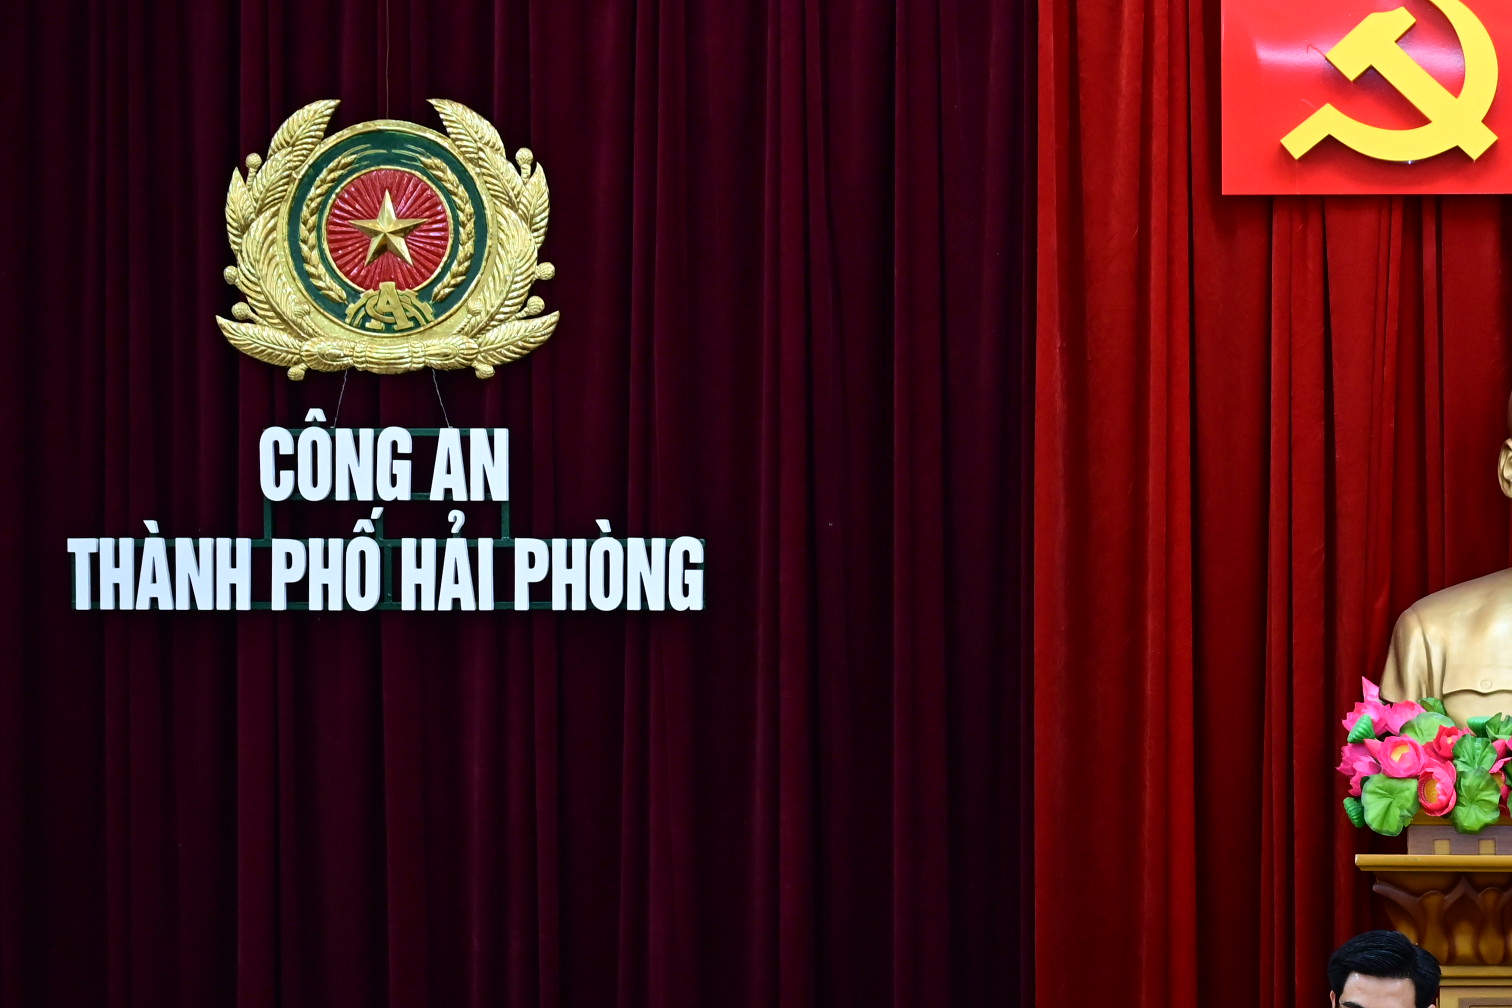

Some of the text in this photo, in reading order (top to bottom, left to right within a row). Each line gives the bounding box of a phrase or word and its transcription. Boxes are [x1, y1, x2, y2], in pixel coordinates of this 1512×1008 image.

[259, 408, 509, 502] CÔNG AN
[67, 507, 704, 611] THÀNH PHỐ HẢI PHÒNG
